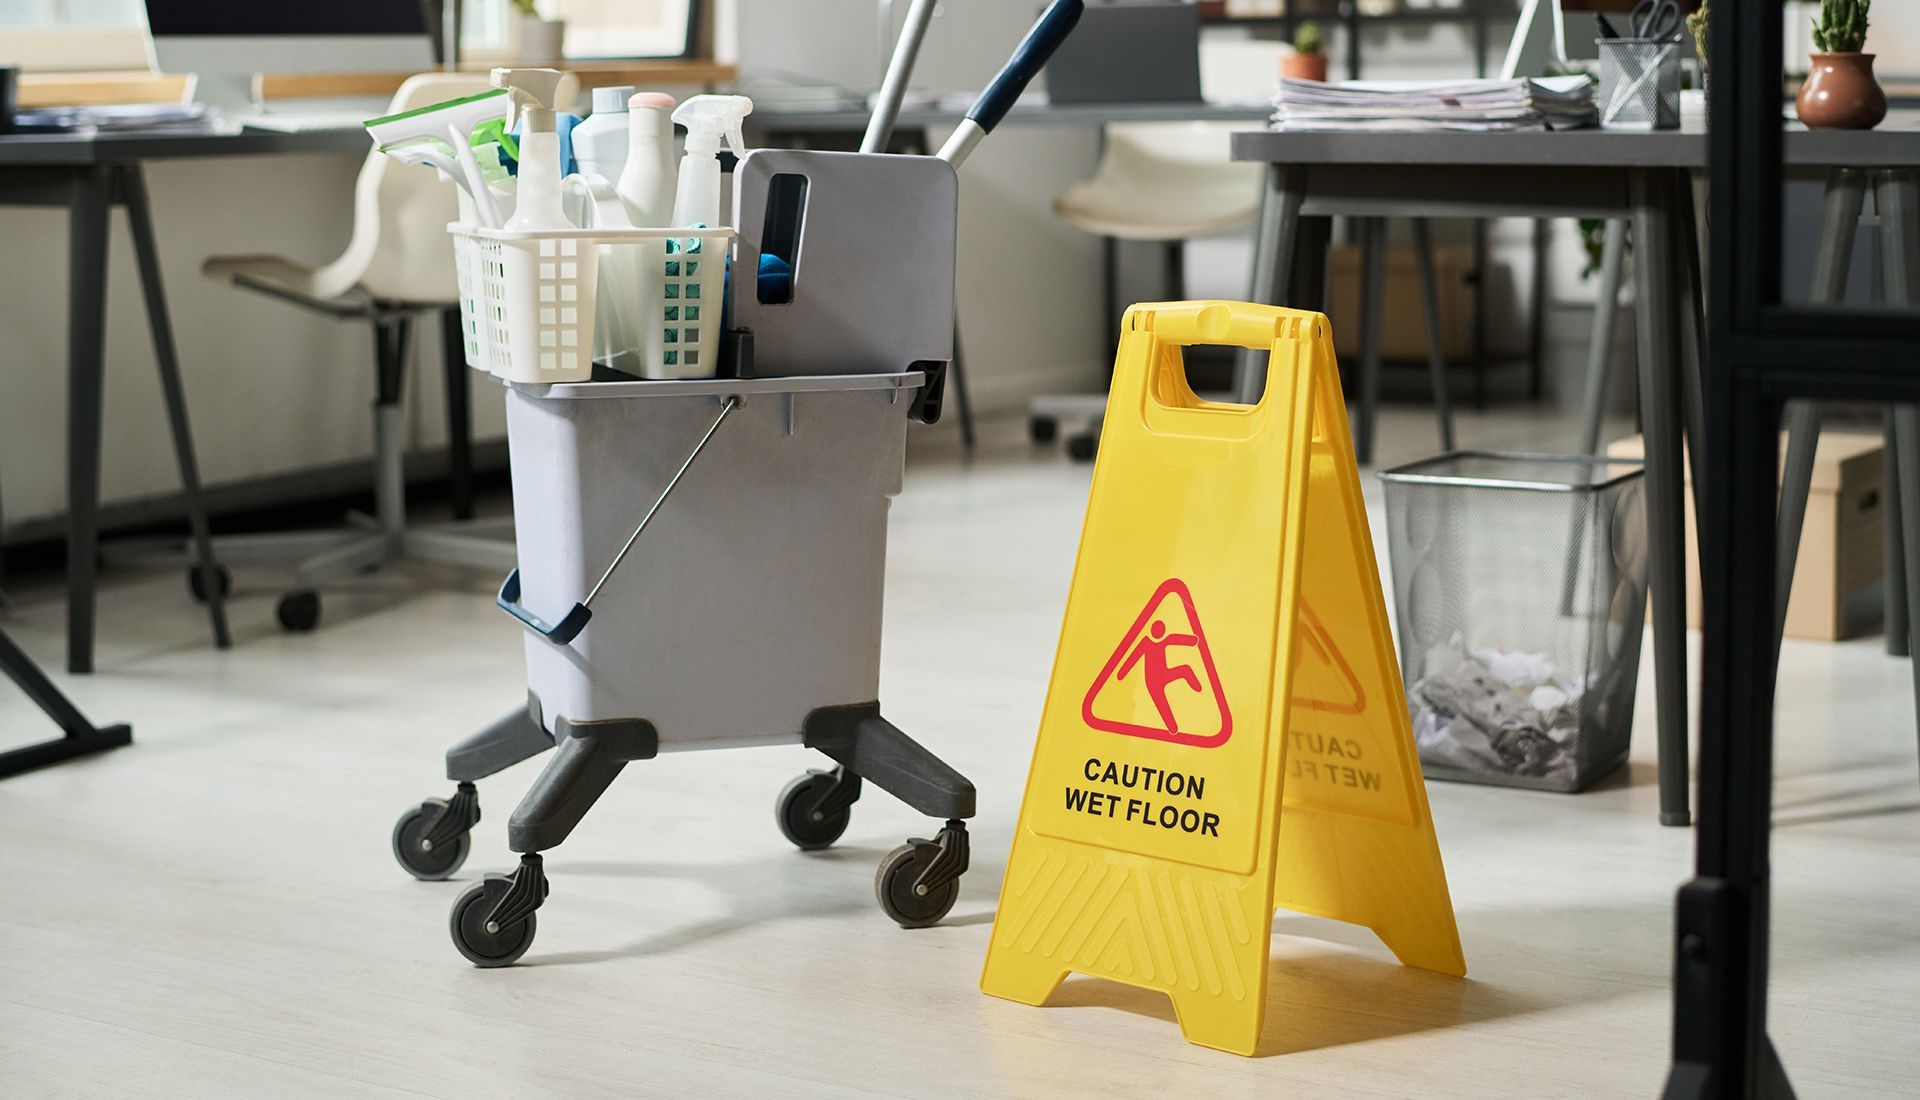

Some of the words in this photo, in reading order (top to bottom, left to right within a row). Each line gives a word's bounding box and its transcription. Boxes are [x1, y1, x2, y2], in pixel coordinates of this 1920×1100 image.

[1084, 758, 1205, 800] CAUTION
[1065, 787, 1121, 818] WET
[1126, 799, 1220, 837] FLOOR
